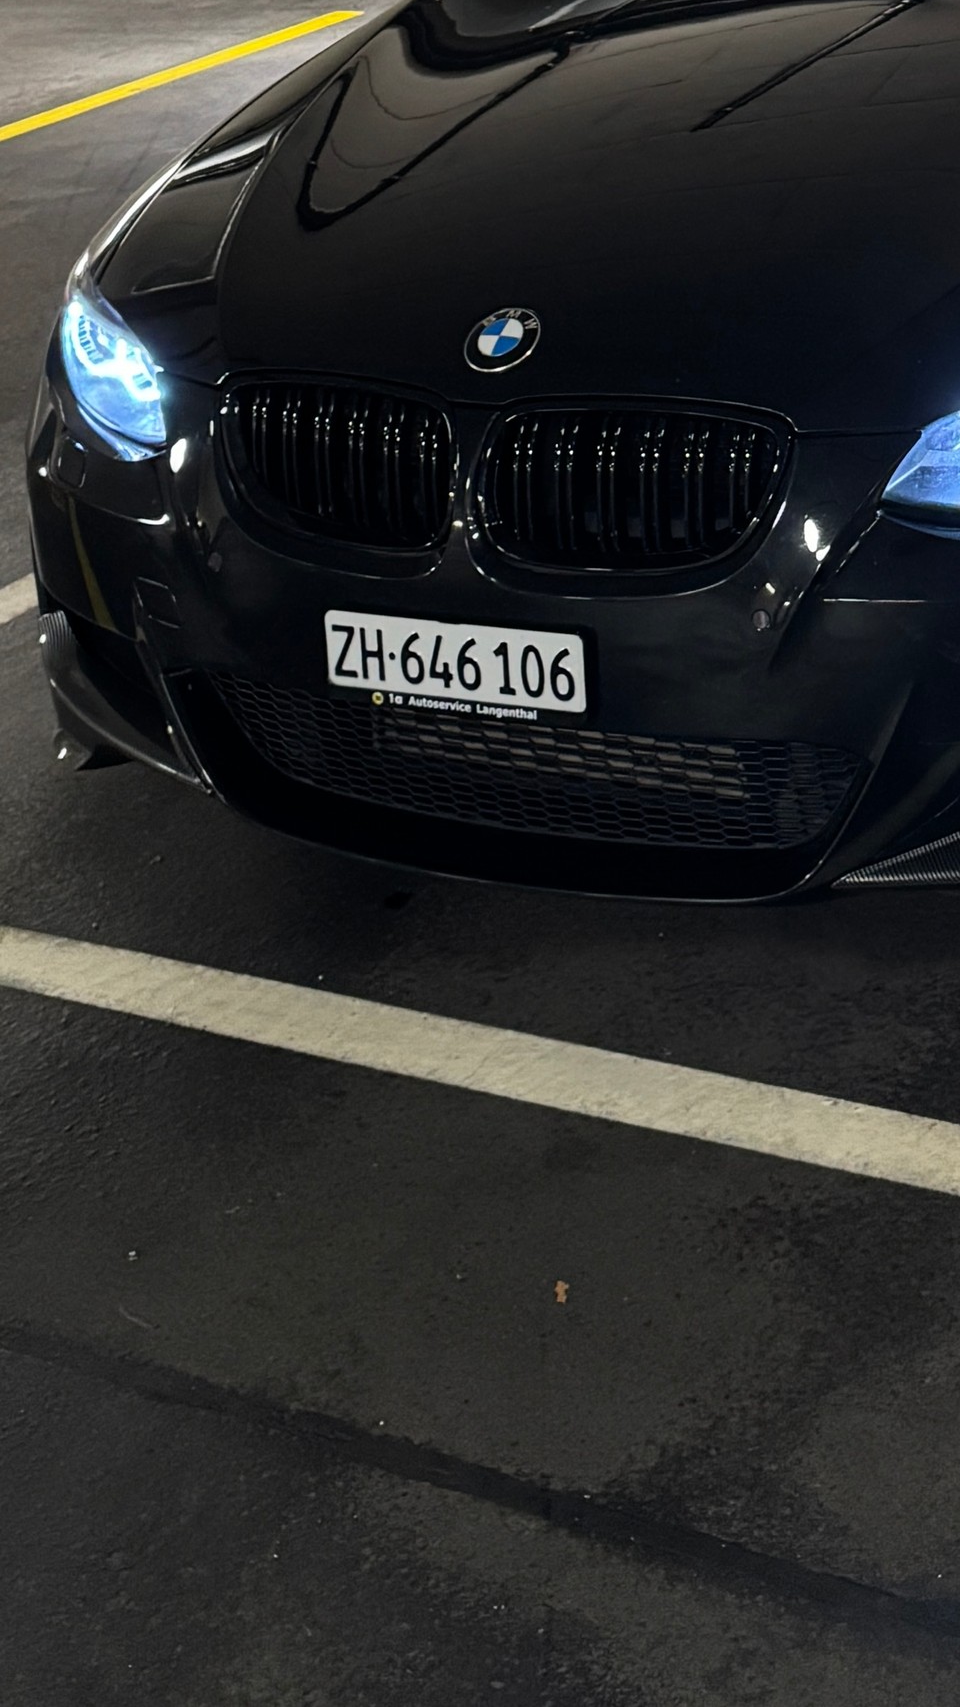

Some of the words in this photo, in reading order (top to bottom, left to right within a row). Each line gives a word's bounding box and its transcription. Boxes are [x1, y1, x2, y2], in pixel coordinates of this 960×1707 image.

[482, 309, 538, 330] BMW
[493, 641, 575, 702] 106
[388, 693, 403, 705] 1a
[408, 696, 472, 713] Autoservice
[476, 704, 538, 721] Langenthal
